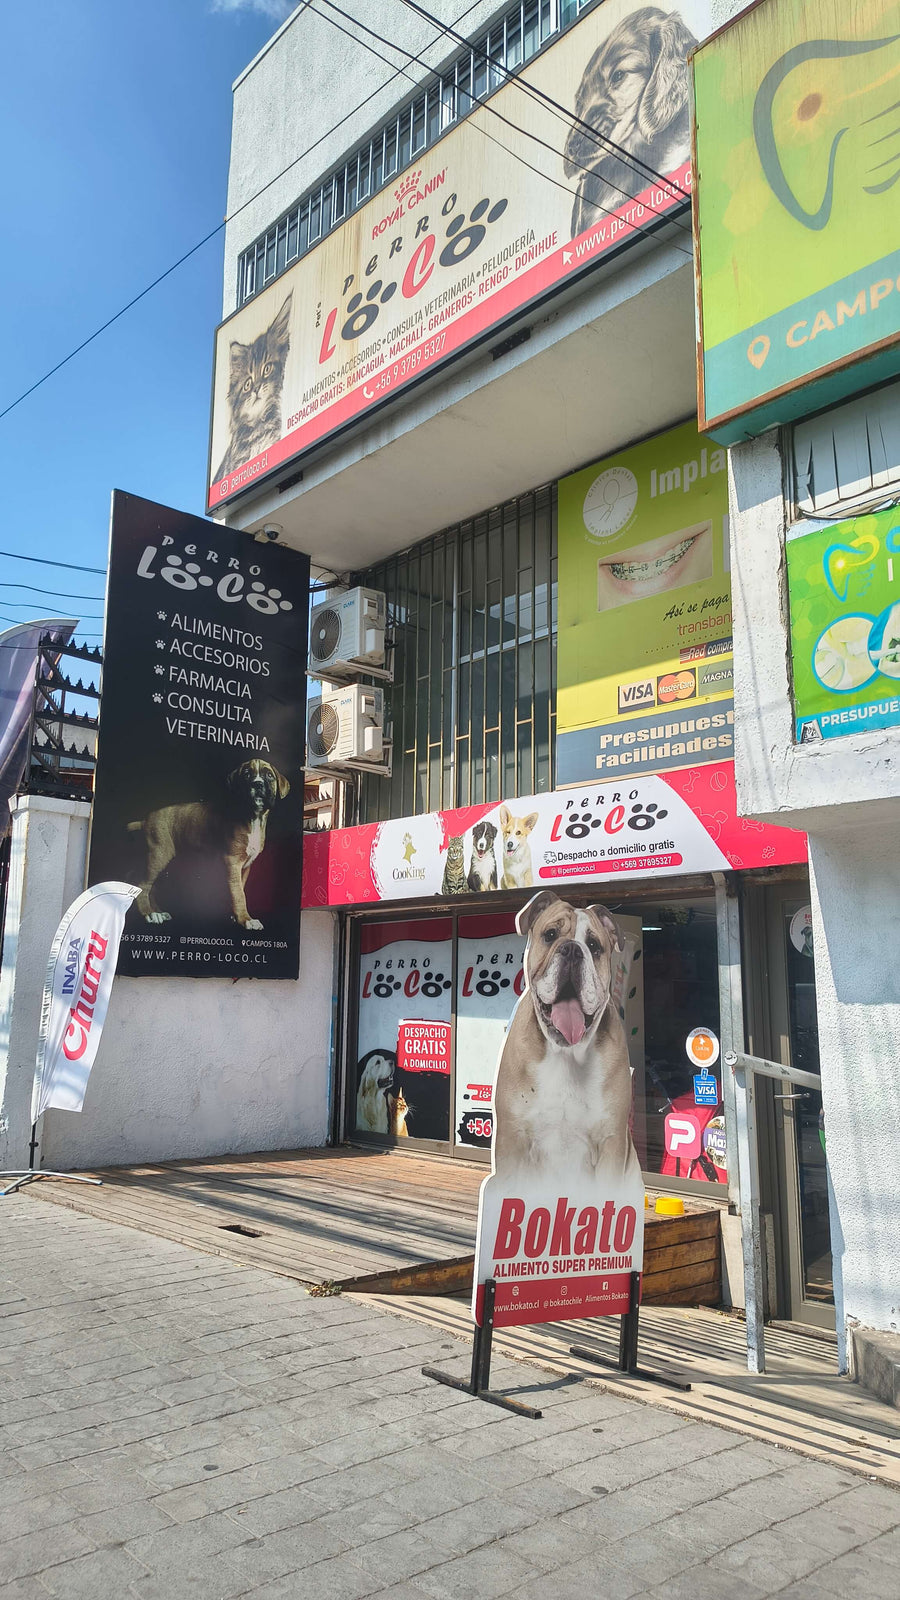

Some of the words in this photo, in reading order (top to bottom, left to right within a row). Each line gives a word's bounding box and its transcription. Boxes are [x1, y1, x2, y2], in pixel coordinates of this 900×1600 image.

[371, 203, 406, 241] ROYAL
[407, 171, 447, 211] CANIN
[342, 193, 457, 296] PERRO
[302, 371, 336, 404] ALIMENTOS
[340, 339, 382, 378] ACCESORIOS
[386, 308, 423, 344] CONSULTA
[424, 272, 475, 317] VETERINARIA
[482, 229, 536, 277] PELUQUERÍA
[286, 398, 319, 430] DESPACHO
[320, 383, 346, 407] GRATIS:
[346, 354, 388, 389] RANCAGUA-
[428, 290, 477, 332] GRANEROS-
[478, 266, 513, 297] RENGO-
[515, 230, 558, 272] DOÑIHUE
[375, 374, 391, 391] +56
[394, 368, 399, 381] 9
[400, 349, 422, 376] 3789
[424, 332, 447, 360] 5327
[231, 453, 268, 491] perroloco.cl
[162, 535, 261, 576] PERRO
[687, 603, 698, 613] se
[700, 594, 729, 613] paga
[171, 613, 263, 651] ALIMENTOS
[170, 638, 271, 677] ACCESORIOS
[688, 645, 707, 660] Red
[169, 665, 252, 700] FARMACIA
[658, 680, 694, 695] MasterCard
[701, 670, 733, 684] MAGNA
[622, 682, 654, 702] VISA
[167, 691, 253, 724] CONSULTA
[821, 700, 900, 728] PRESUPUE
[166, 716, 271, 753] VETERINARIA
[595, 733, 733, 770] Facilidades
[566, 789, 639, 810] PERRO
[557, 849, 598, 862] Despacho
[607, 843, 646, 856] domicilio
[648, 839, 675, 854] gratis
[392, 866, 426, 880] CooKing
[620, 859, 637, 869] +569
[639, 856, 672, 867] 37895327
[136, 935, 154, 943] 3789
[154, 935, 171, 943] 5327
[246, 939, 272, 948] CAMPOS
[273, 941, 288, 949] 180A
[62, 937, 82, 995] INABA
[131, 950, 268, 963] WWW.PERRO-LOCO.CL
[374, 957, 431, 970] PERRO
[63, 930, 109, 1061] Churu
[404, 1027, 447, 1038] DESPACHO
[404, 1039, 447, 1055] GRATIS
[404, 1058, 409, 1068] A
[410, 1059, 447, 1070] DOMICILIO
[696, 1086, 716, 1095] VISA
[467, 1118, 492, 1137] +56
[492, 1197, 637, 1260] Bokato
[493, 1261, 549, 1278] ALIMENTO
[552, 1258, 586, 1273] SUPER
[588, 1256, 632, 1270] PREMIUM
[585, 1294, 611, 1303] Alimentos
[612, 1292, 629, 1301] Bokato
